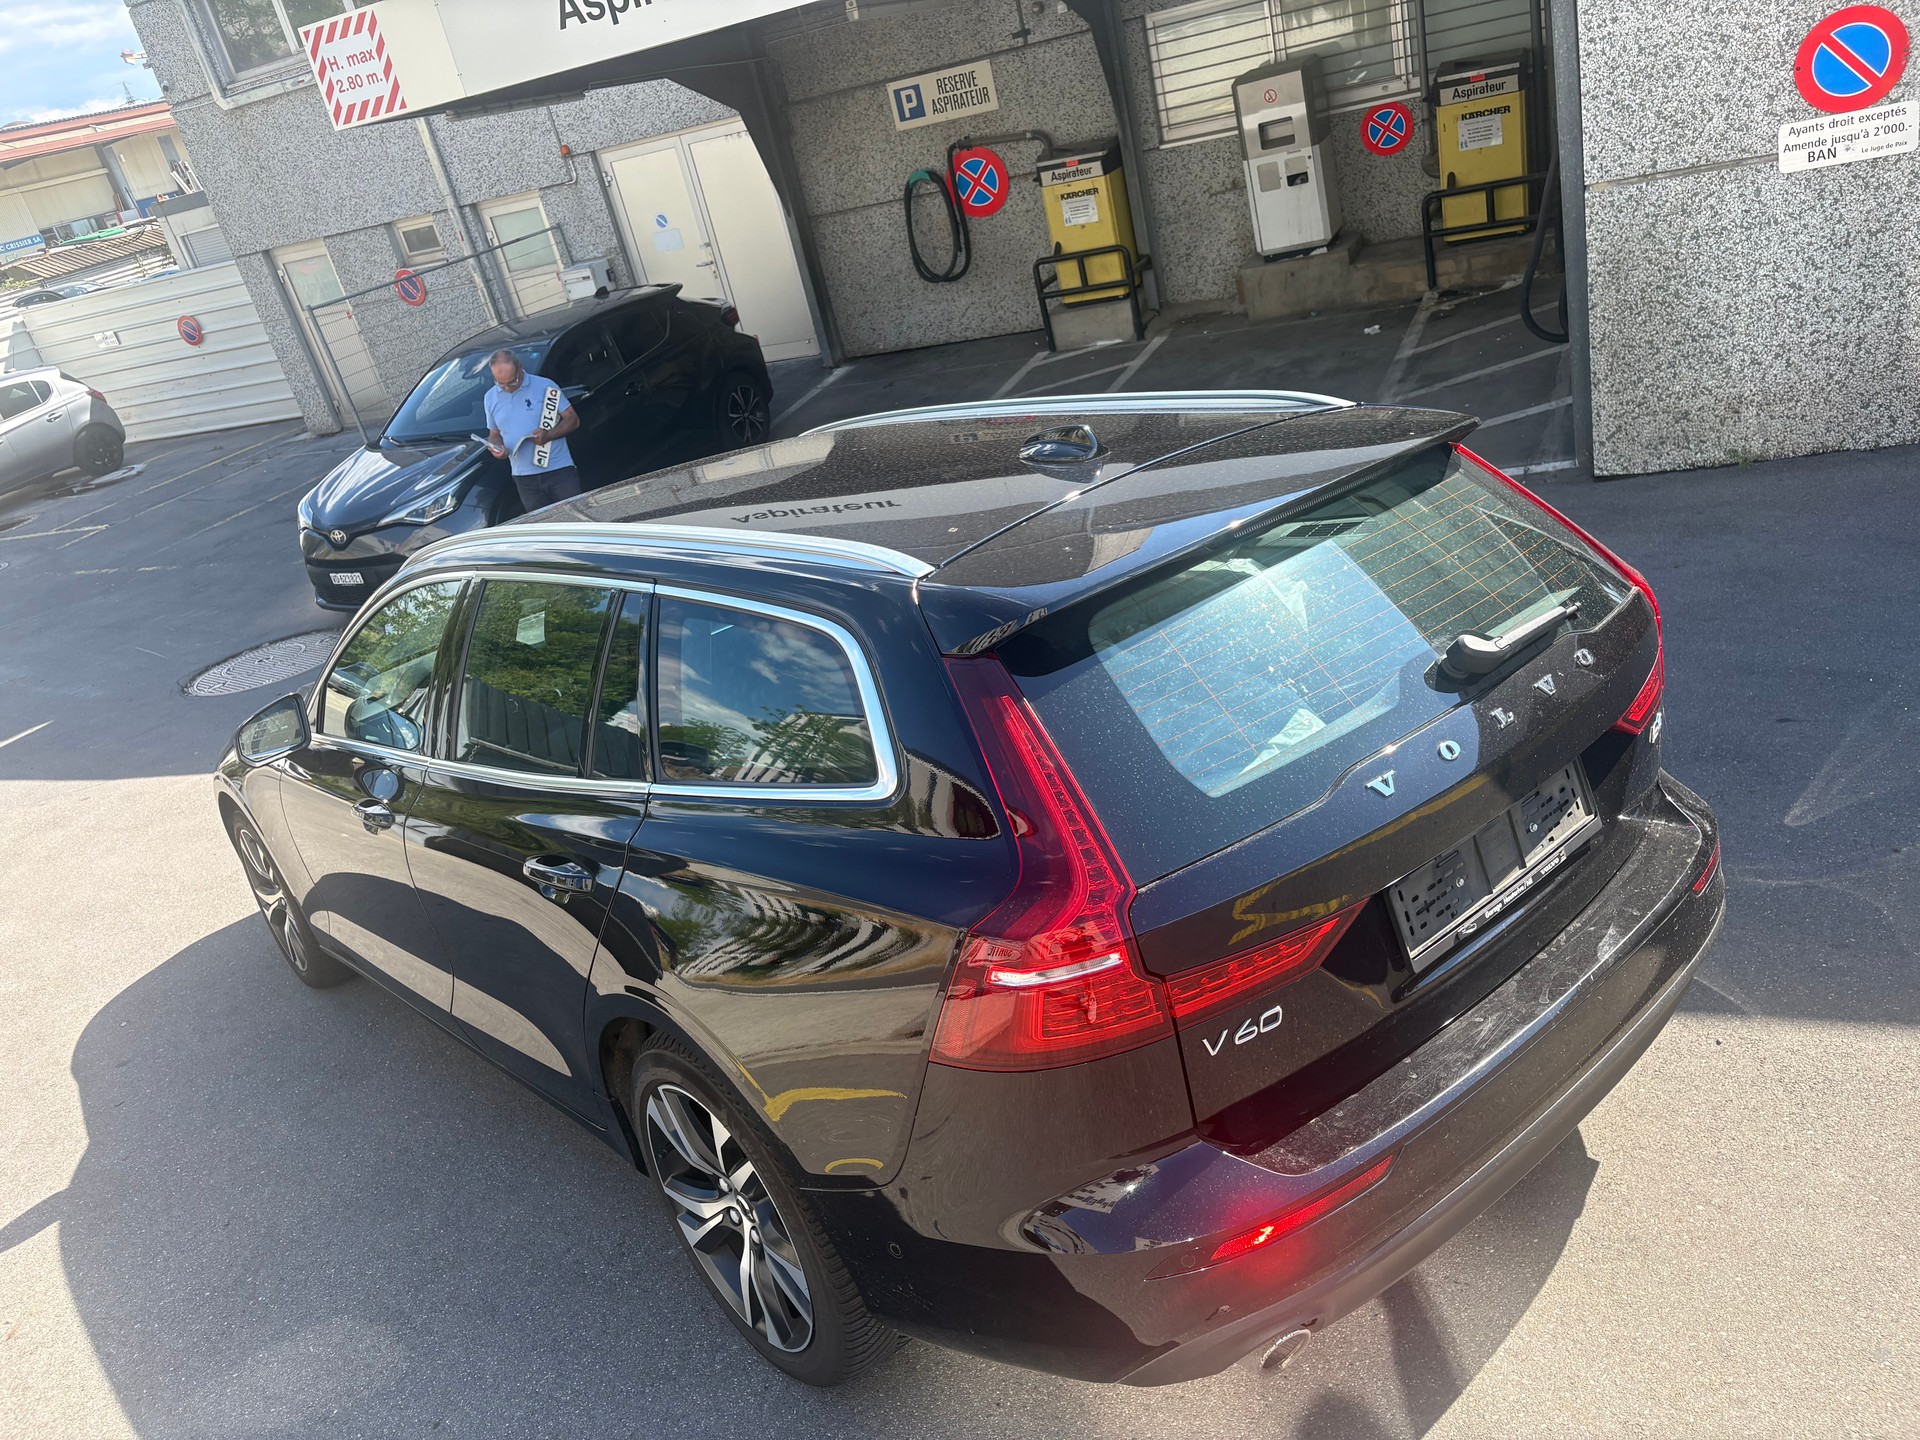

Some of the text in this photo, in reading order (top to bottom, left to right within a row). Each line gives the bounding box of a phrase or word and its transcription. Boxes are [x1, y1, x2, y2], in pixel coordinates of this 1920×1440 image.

[327, 48, 376, 73] H. max
[336, 71, 383, 94] 2.80 m.
[936, 70, 979, 96] RESERVE
[1452, 81, 1507, 100] Aspirateur
[931, 86, 991, 116] ASPIRATEUR
[1788, 105, 1907, 138] Ayants droit exceptés
[1783, 136, 1828, 154] Amende
[1807, 146, 1837, 163] BAN
[1869, 143, 1885, 152] Juge
[1885, 142, 1894, 150] de
[1895, 140, 1908, 148] Paix
[1051, 166, 1093, 182] Aspirateur
[5, 236, 32, 250] CRISSIER
[1364, 647, 1595, 798] VOLVO
[1484, 902, 1503, 919] Garage
[1201, 1005, 1283, 1057] V60
